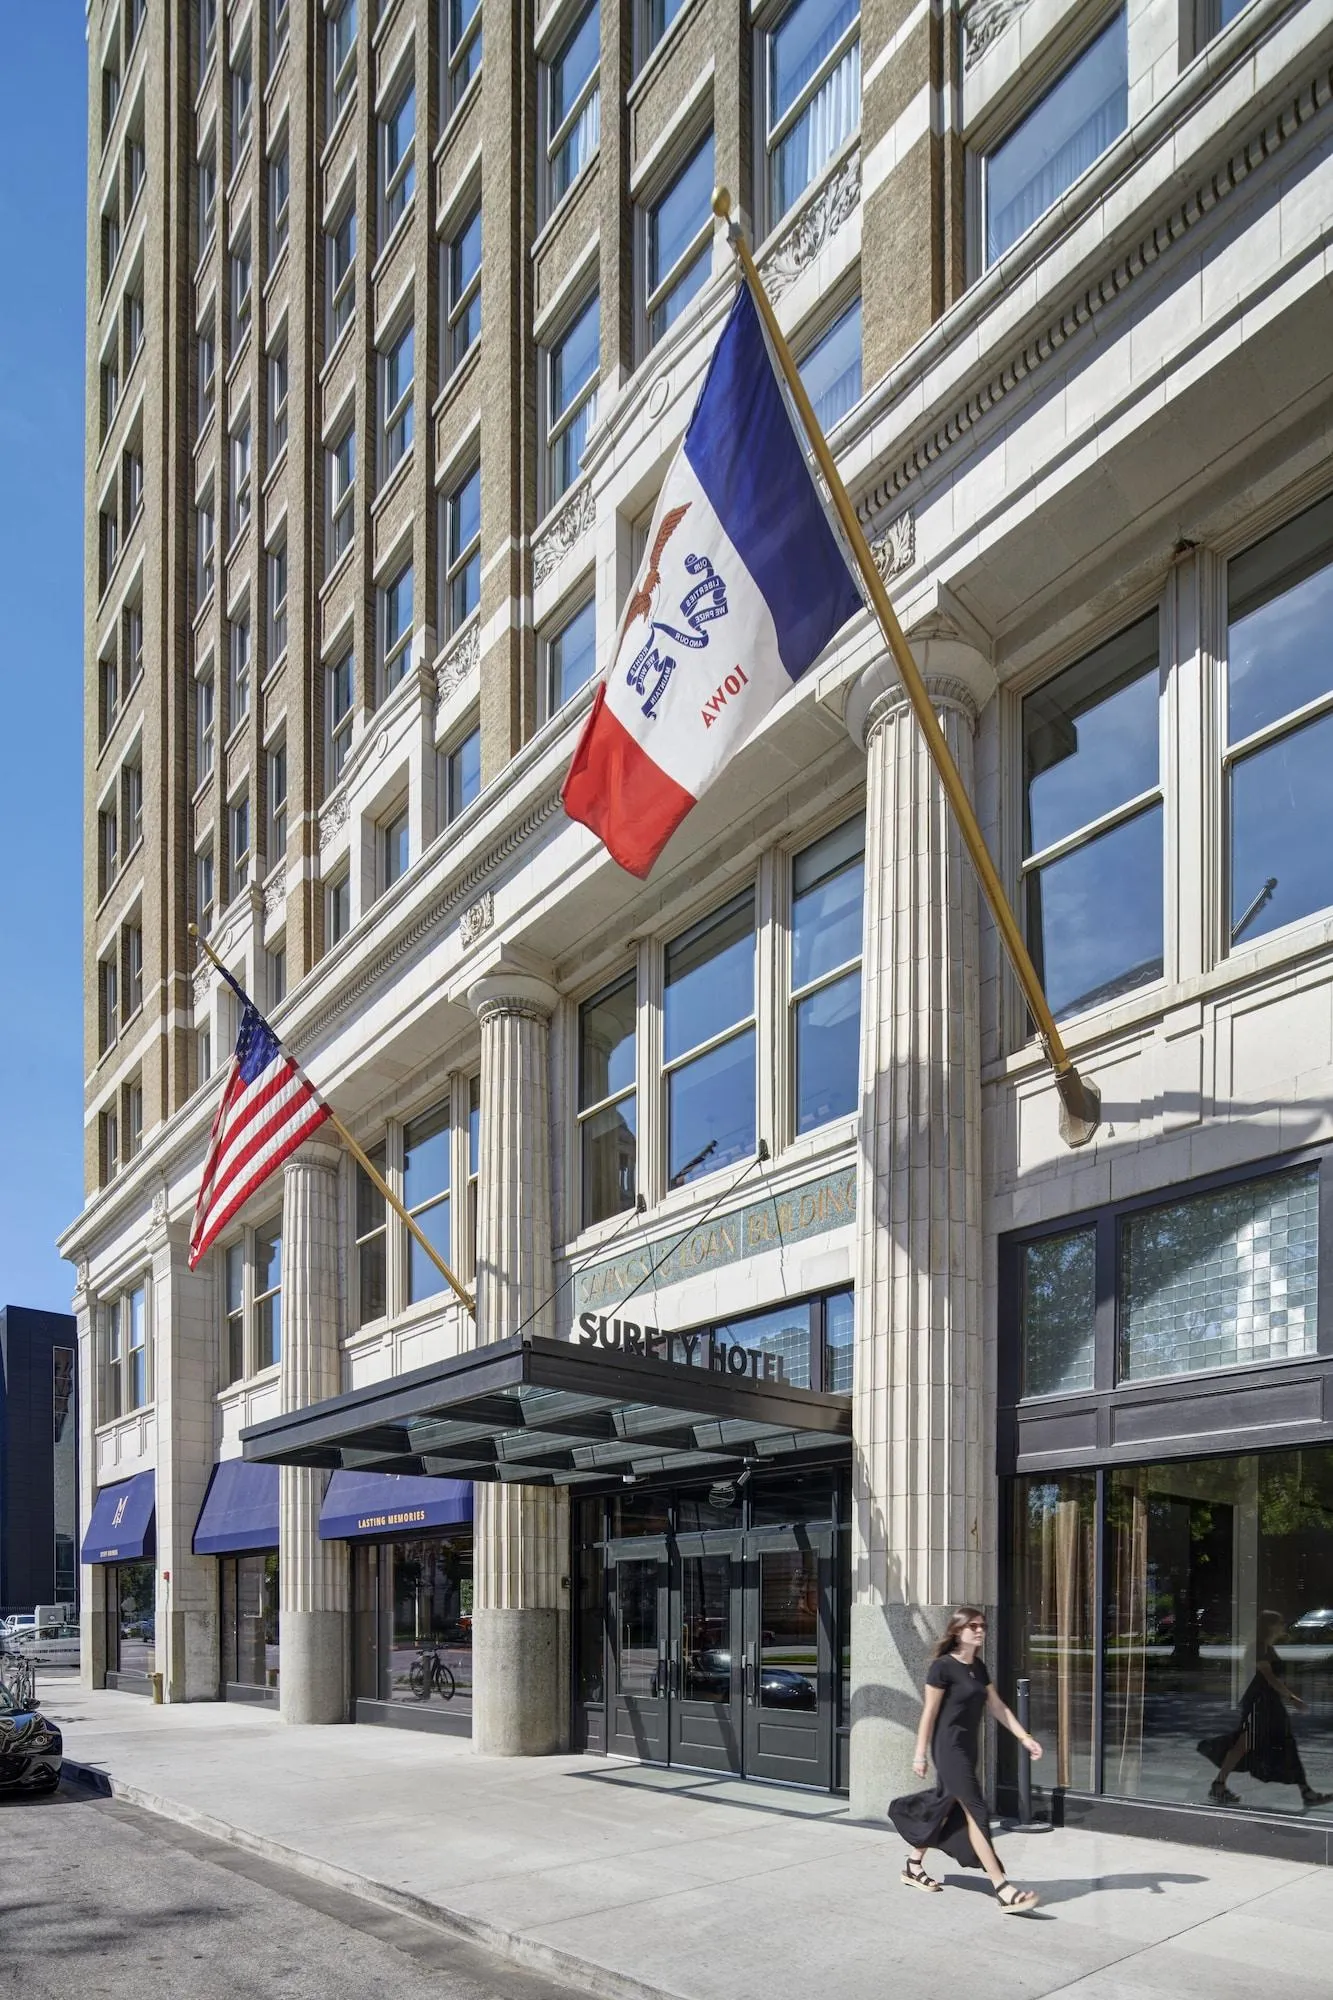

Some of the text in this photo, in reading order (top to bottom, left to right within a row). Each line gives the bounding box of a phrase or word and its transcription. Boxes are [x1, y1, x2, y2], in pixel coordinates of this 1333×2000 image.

[679, 1223, 735, 1269] LOAN
[579, 1312, 790, 1386] SURETY HOTEL
[358, 1510, 425, 1529] LASTING MEMORIES
